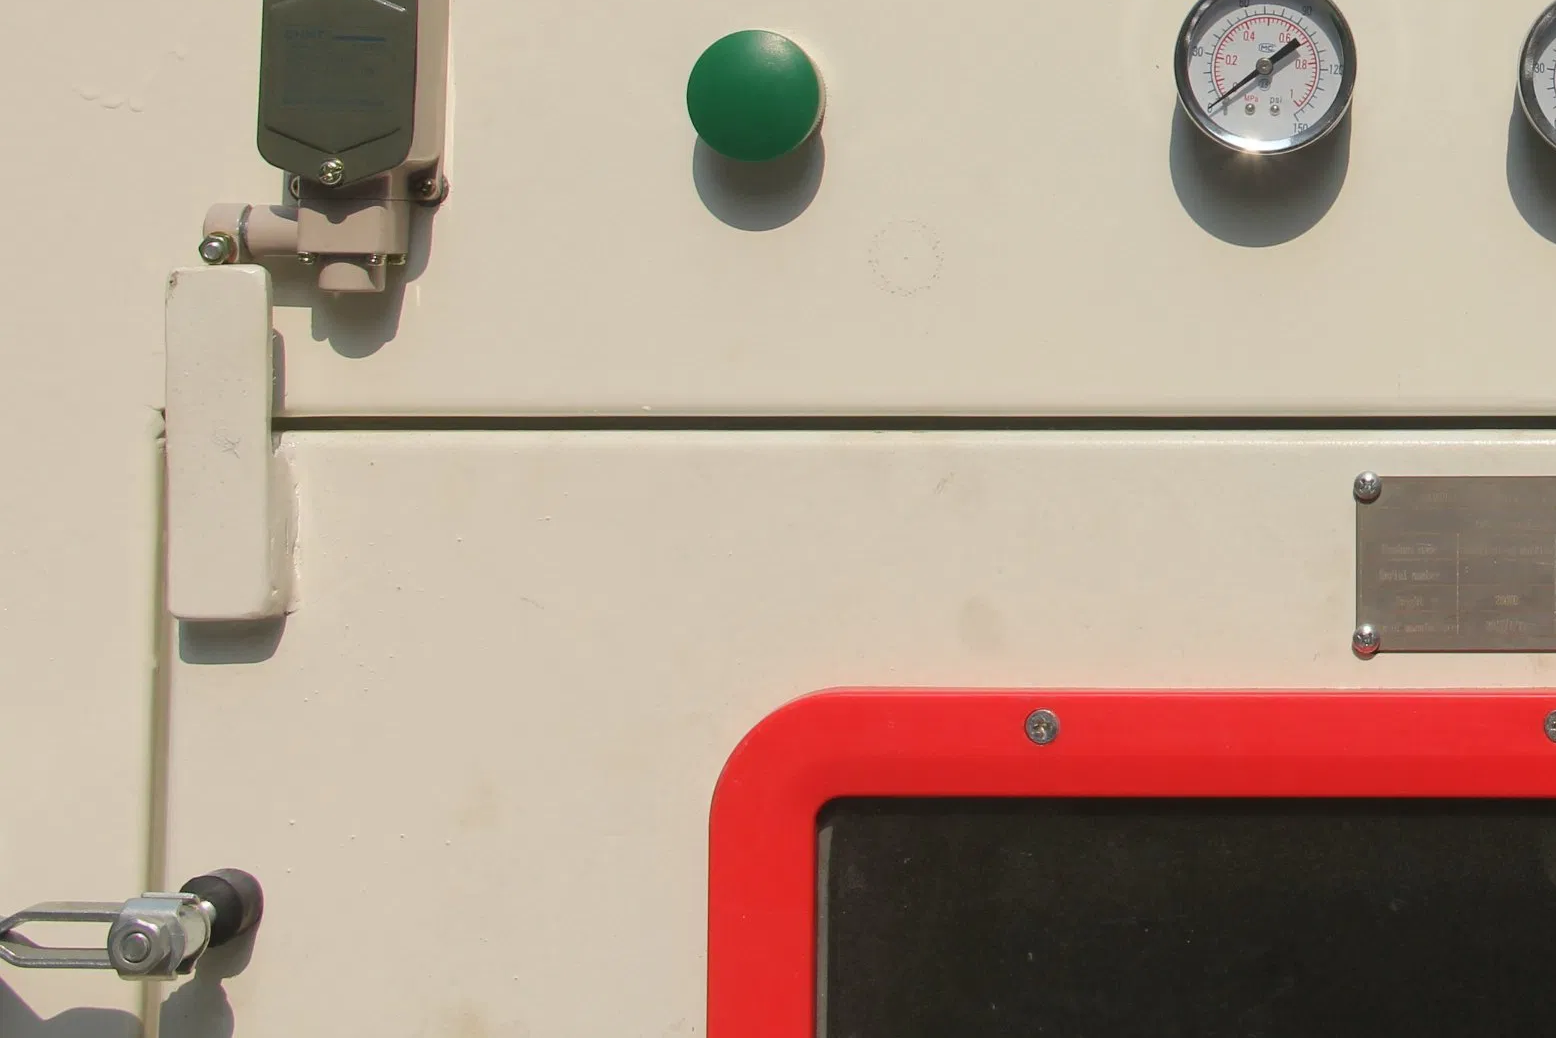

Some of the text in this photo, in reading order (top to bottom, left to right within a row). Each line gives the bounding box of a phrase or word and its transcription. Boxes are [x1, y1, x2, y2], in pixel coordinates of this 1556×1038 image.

[1302, 6, 1312, 15] 90
[1243, 32, 1254, 41] 0.4
[1279, 33, 1290, 42] 0.6
[1193, 48, 1203, 56] 30
[1226, 55, 1237, 65] 0.2
[1296, 59, 1306, 69] 0.8
[1329, 64, 1343, 74] 120
[1534, 63, 1544, 73] 30
[1270, 96, 1282, 104] psi
[1294, 124, 1308, 133] 150
